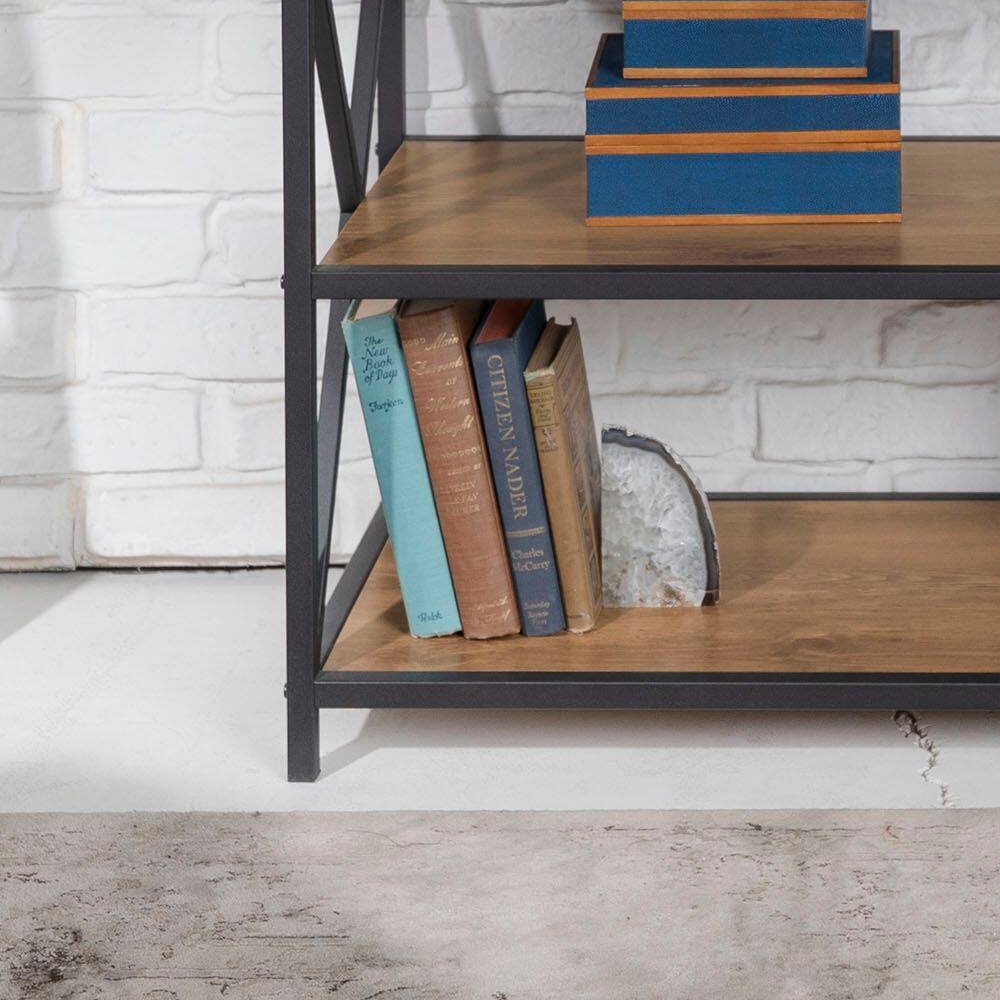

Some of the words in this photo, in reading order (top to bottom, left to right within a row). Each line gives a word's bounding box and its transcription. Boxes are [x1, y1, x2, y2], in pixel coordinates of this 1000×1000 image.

[363, 336, 384, 347] The
[361, 347, 389, 360] New
[362, 355, 394, 373] Book
[364, 370, 375, 385] of
[487, 354, 516, 442] CITIZEN
[503, 446, 529, 520] NADER
